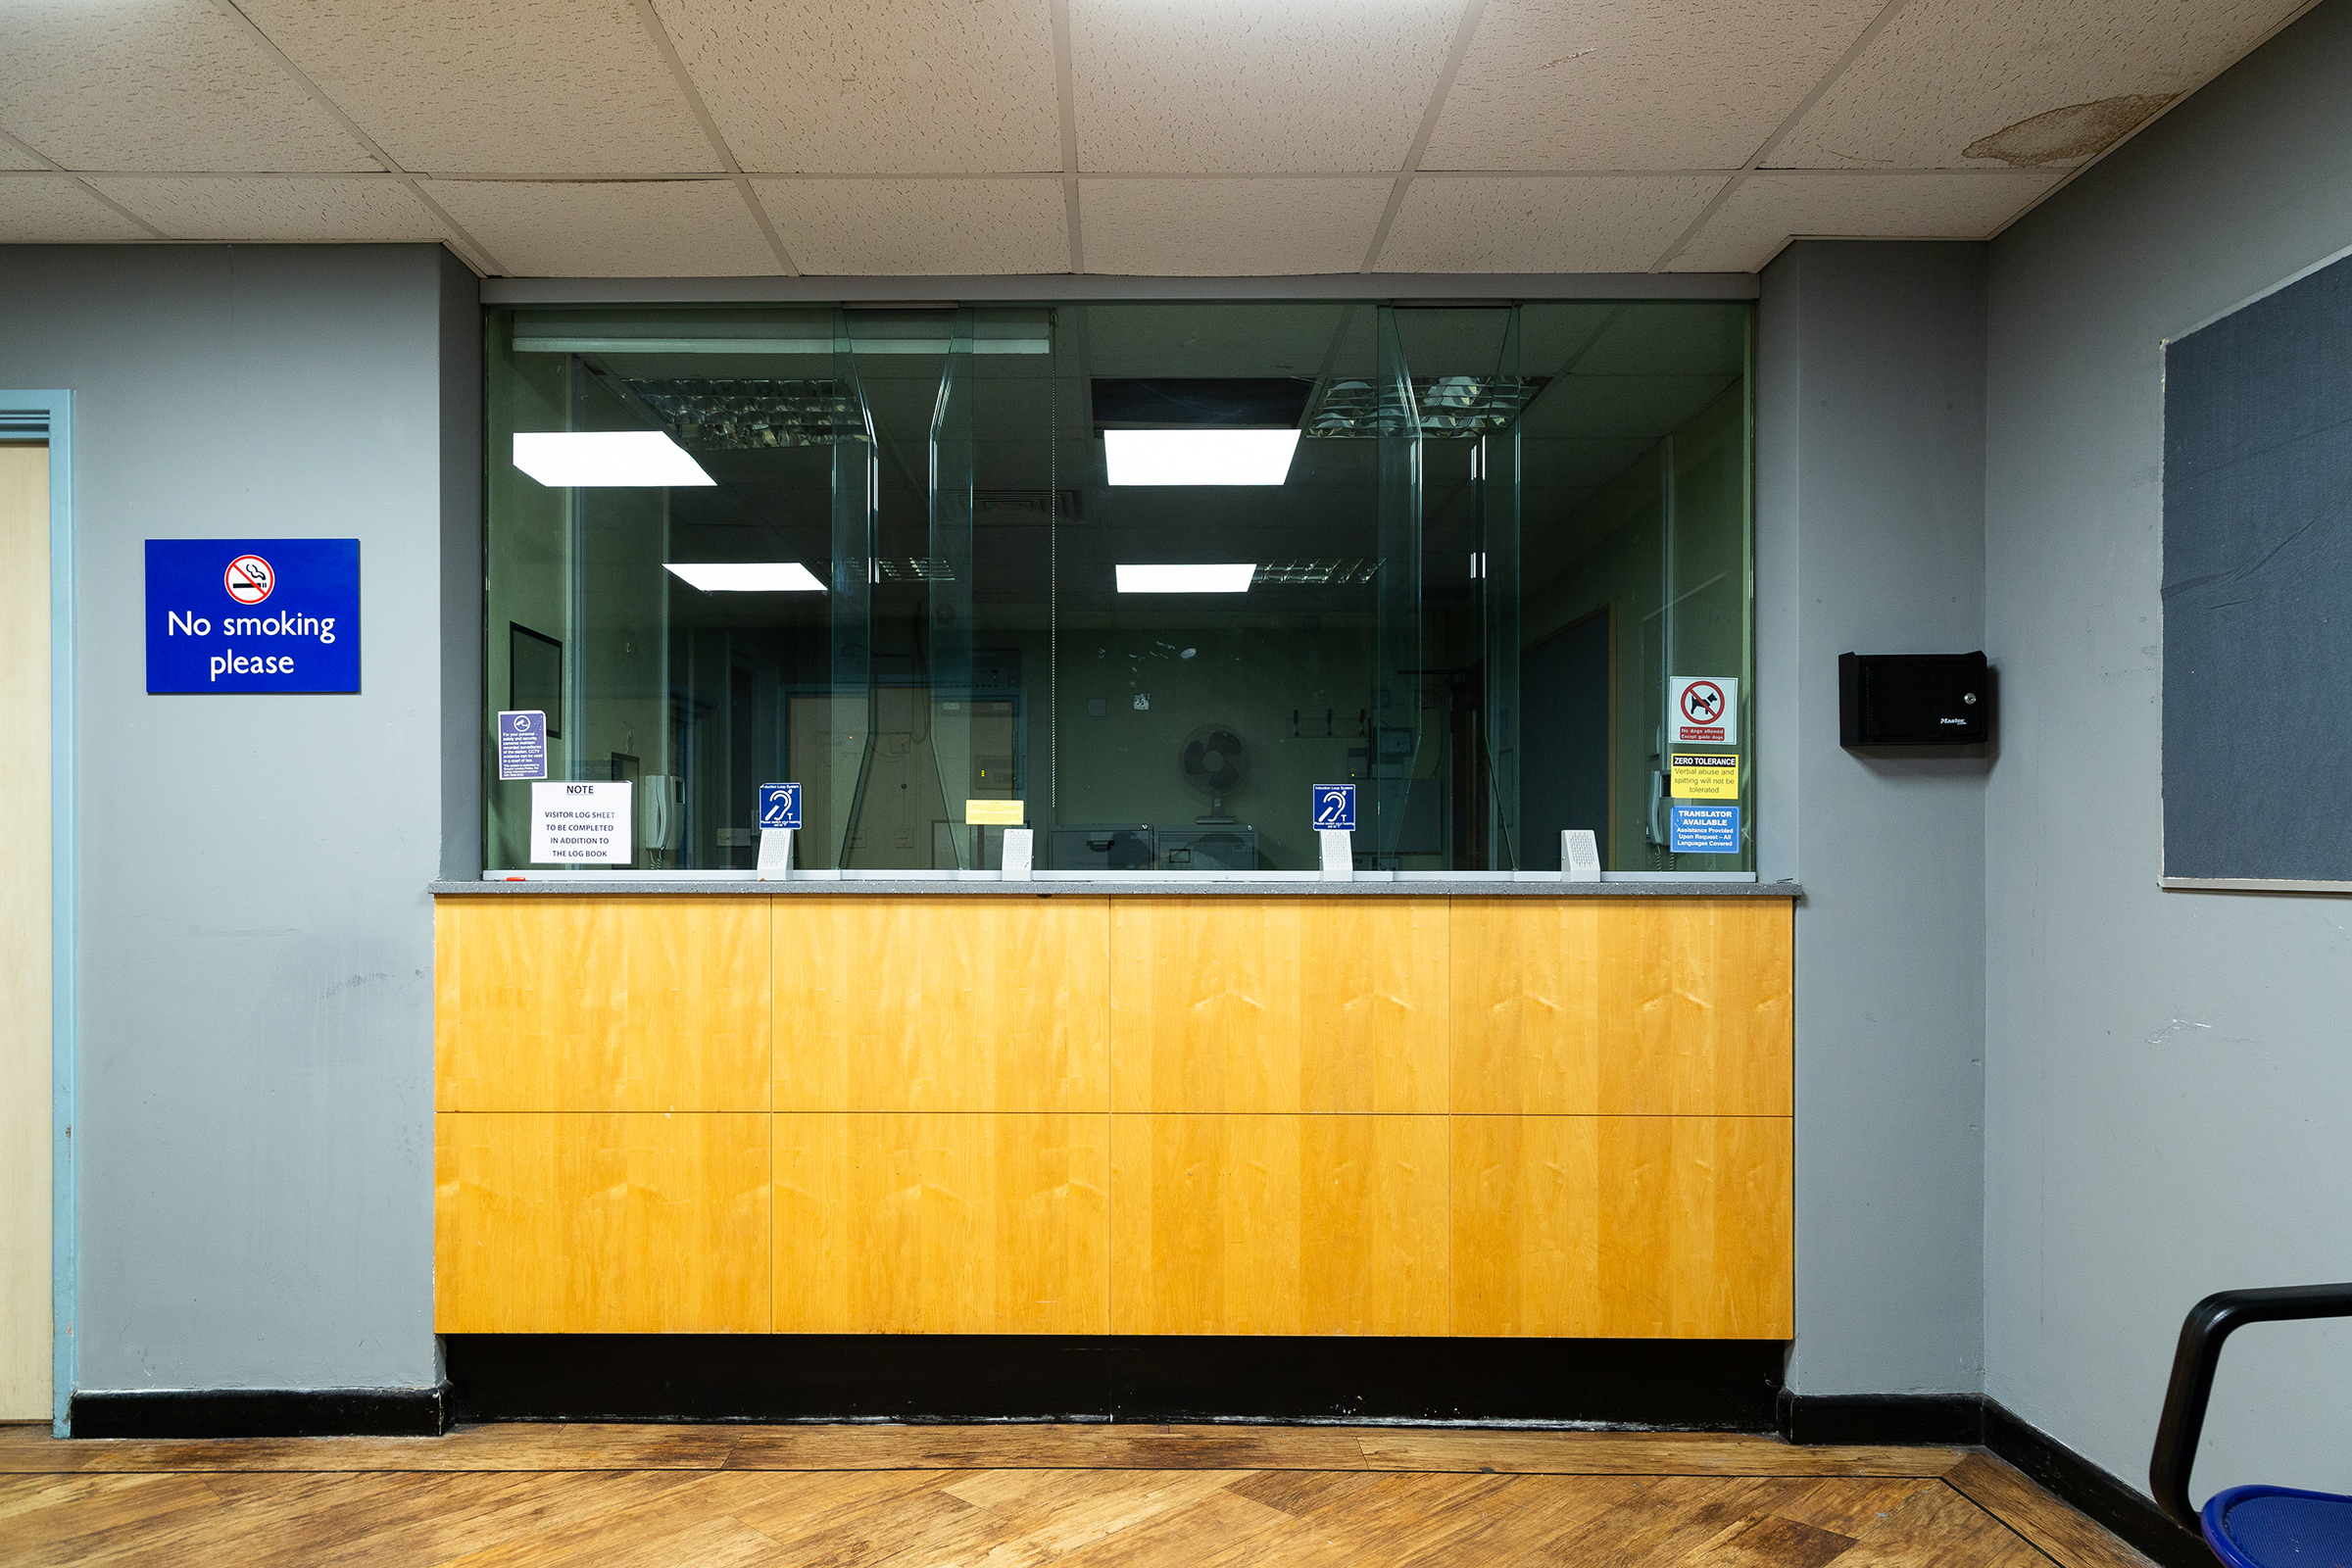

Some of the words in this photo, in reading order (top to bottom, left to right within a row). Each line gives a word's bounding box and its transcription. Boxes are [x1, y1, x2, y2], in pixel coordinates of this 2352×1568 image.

[168, 610, 211, 636] No
[223, 610, 336, 644] smoking
[210, 649, 294, 682] please
[1694, 757, 1735, 766] TOLERANCE
[1674, 777, 1699, 785] spitting
[566, 785, 594, 794] NOTE
